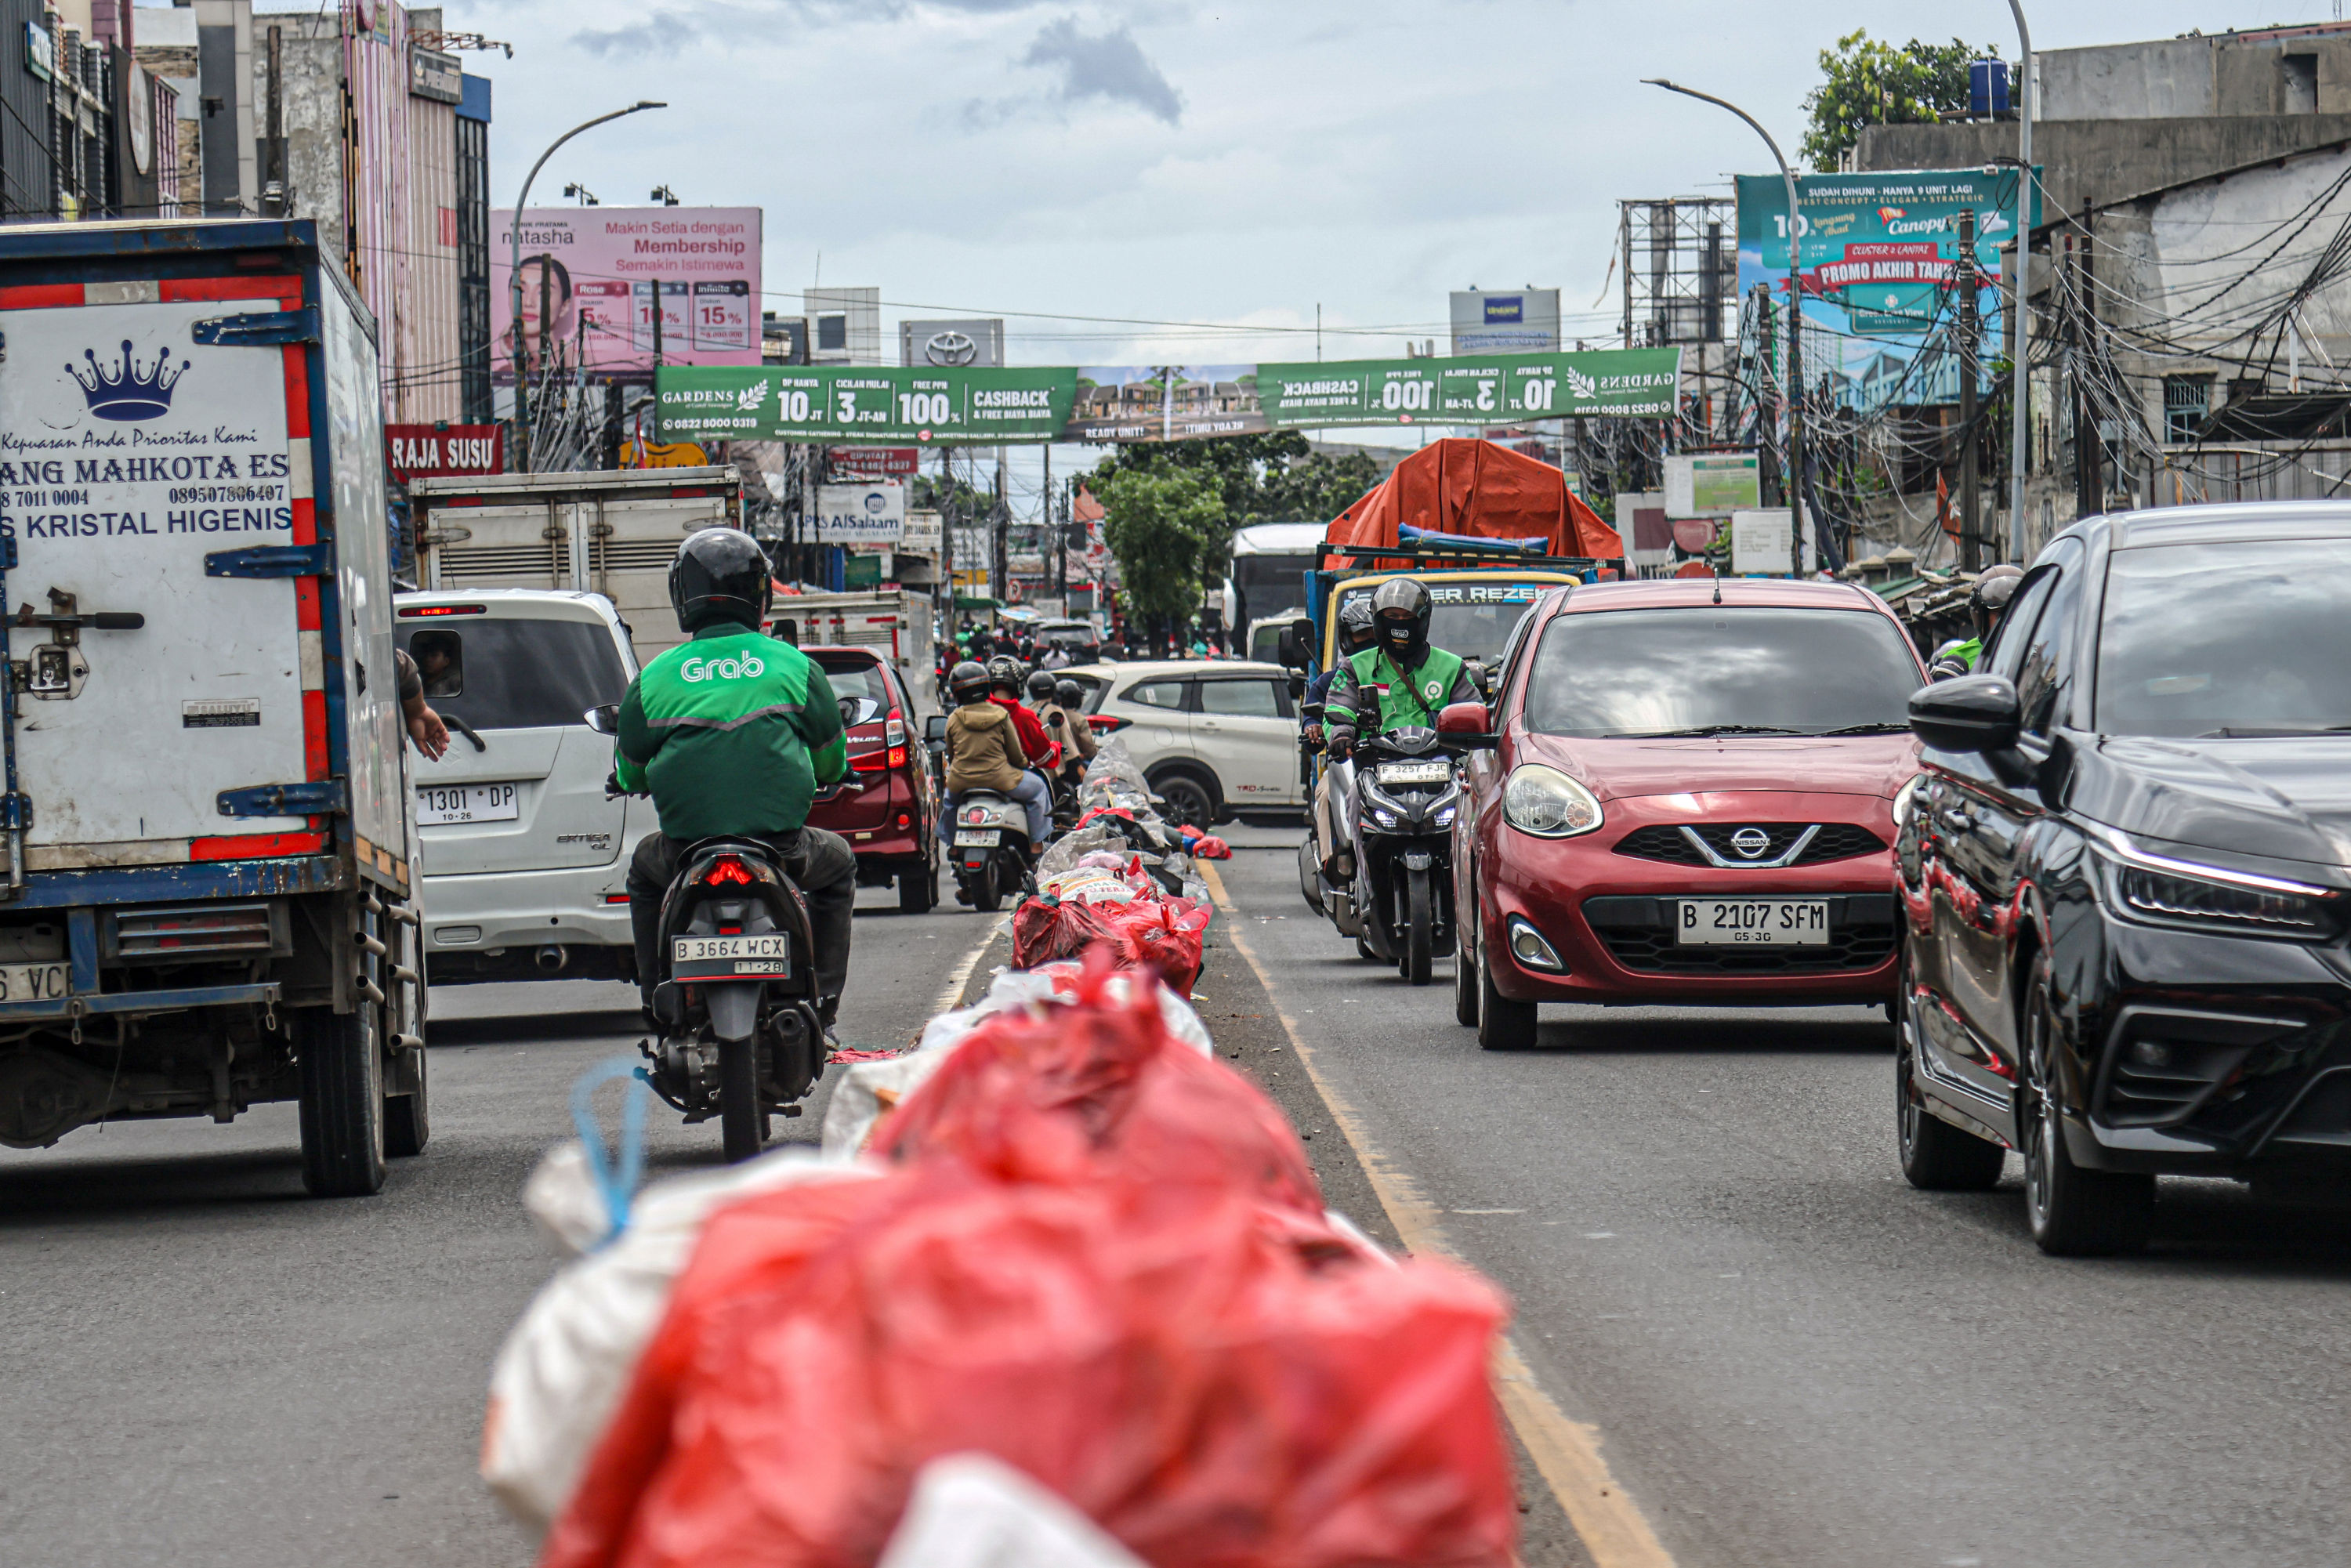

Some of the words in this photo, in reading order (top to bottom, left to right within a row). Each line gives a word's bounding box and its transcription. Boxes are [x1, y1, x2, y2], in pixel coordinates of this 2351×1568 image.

[1808, 186, 1840, 197] SUDAH
[1842, 186, 1875, 196] DIHUNI
[1882, 186, 1914, 195] HANYA
[1925, 185, 1947, 195] UNIT
[1951, 184, 1973, 194] LAGI
[1929, 194, 1984, 203] STRATEGIC
[606, 221, 649, 234] Makin
[651, 221, 687, 234] Setia
[690, 220, 744, 237] dengan
[1773, 214, 1809, 238] 10
[1889, 216, 1947, 235] Canopy
[502, 229, 574, 244] natasha
[634, 238, 745, 257] Membership
[616, 258, 678, 271] Semakin
[681, 259, 744, 271] Istimewa
[1820, 262, 1871, 285] PROMO
[1872, 259, 1915, 280] AKHIR
[579, 285, 607, 295] Rose
[698, 284, 730, 294] Infinite
[1904, 308, 1925, 317] View
[782, 378, 793, 387] DP
[793, 378, 820, 388] HANYA
[835, 378, 865, 389] CICILAN
[865, 379, 890, 389] MULAI
[912, 380, 932, 389] FREE
[933, 381, 948, 389] PPN
[662, 391, 734, 404] GARDENS
[777, 390, 809, 423] 10
[810, 410, 823, 421] JT
[836, 391, 856, 424] 3
[857, 411, 887, 422] JT-AN
[973, 411, 980, 420] &
[982, 411, 1002, 420] FREE
[1003, 410, 1027, 420] BIAYA
[1027, 409, 1052, 419] BIAYA
[674, 418, 701, 429] 0822
[702, 418, 731, 429] 8000
[2, 432, 78, 455] Kepuasan
[82, 429, 127, 450] Anda
[132, 428, 208, 448] Prioritas
[214, 425, 258, 444] Kami
[1085, 429, 1116, 439] READY
[1118, 427, 1144, 437] UNIT!
[392, 437, 441, 469] RAJA
[447, 437, 494, 469] SUSU
[74, 456, 239, 484] MAHKOTA
[249, 454, 291, 480] ES
[15, 491, 47, 508] 7011
[52, 489, 89, 506] 0004
[27, 512, 158, 539] KRISTAL
[167, 507, 293, 534] HIGENIS
[831, 515, 899, 530] AlSalaam
[680, 650, 765, 683] Grab
[427, 789, 467, 812] 1301
[490, 787, 513, 807] DP
[557, 832, 611, 845] ERTIGA
[591, 842, 610, 851] GL
[1683, 904, 1697, 929] B
[1714, 904, 1772, 929] 2107
[1780, 904, 1824, 930] SFM
[677, 942, 687, 958] B
[697, 941, 740, 957] 3664
[747, 939, 782, 954] WCX
